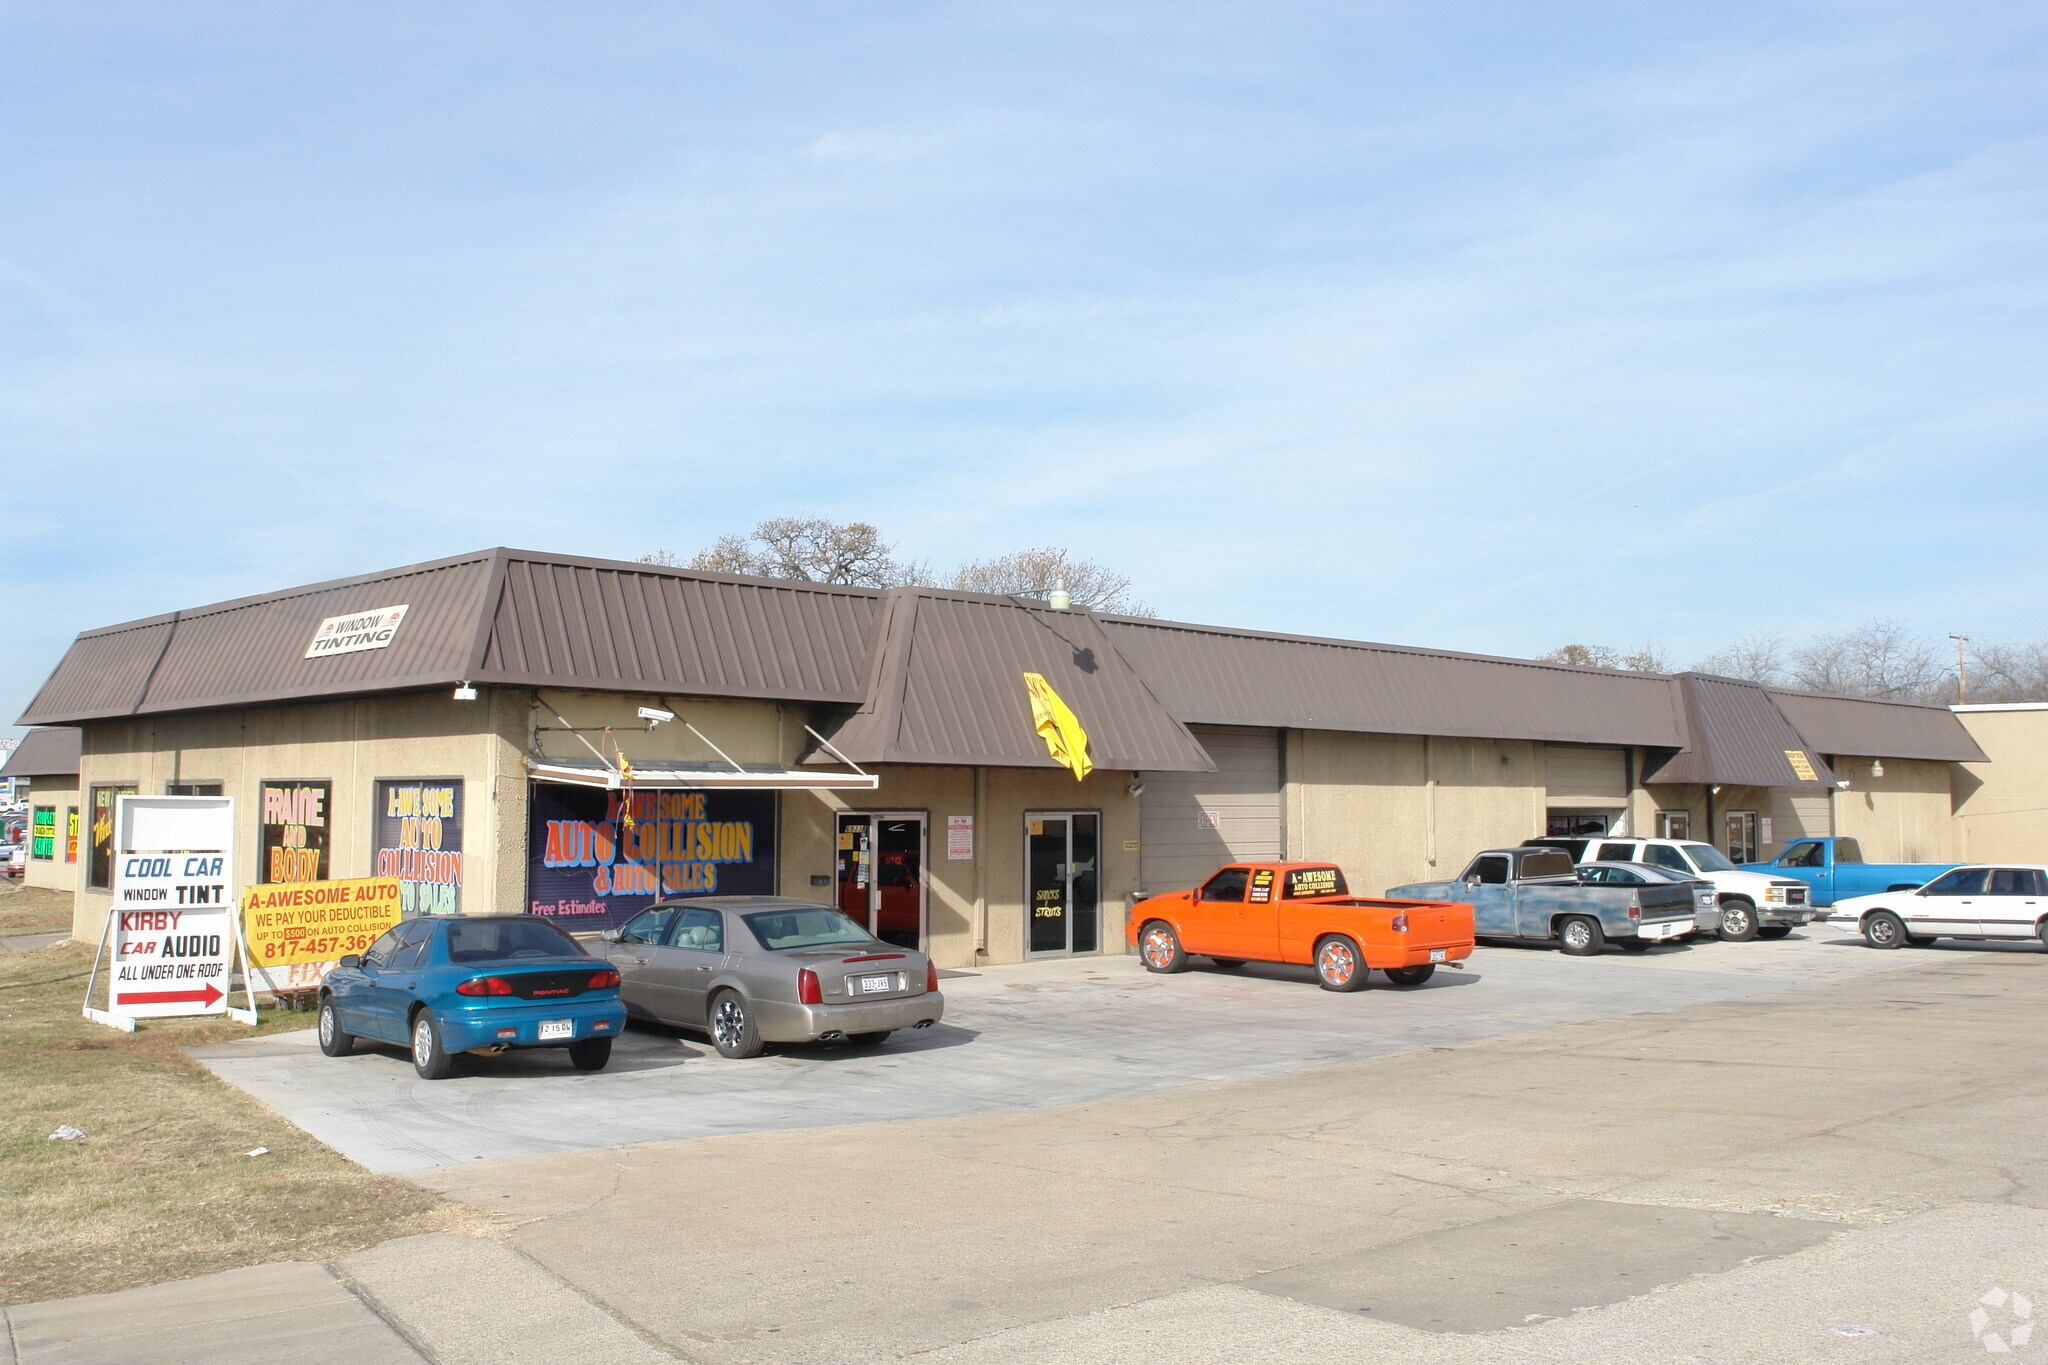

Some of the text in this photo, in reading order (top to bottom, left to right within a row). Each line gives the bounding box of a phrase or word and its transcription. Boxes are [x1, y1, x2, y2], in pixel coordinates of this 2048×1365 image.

[336, 614, 383, 634] WINDOW
[314, 630, 392, 651] TINTING
[264, 787, 325, 827] FRAME
[283, 825, 306, 848] AND
[399, 816, 443, 850] AUTO
[544, 820, 753, 867] AUTO COLLISION
[125, 857, 224, 878] COOL CAR
[271, 847, 320, 883] BODY
[377, 848, 463, 886] COLLISION
[593, 862, 718, 896] & AUTO SALES
[1309, 882, 1334, 890] COLLISION
[124, 885, 224, 904] WINDOW TINT
[248, 884, 398, 910] A-AWESOME AUTO
[419, 884, 456, 915] SALES
[255, 905, 391, 927] WE PAY YOUR DEDUCTIBLE
[532, 899, 606, 915] Free Estimates
[1035, 906, 1062, 917] STRUTS
[120, 911, 183, 932] KIRBY
[256, 932, 268, 941] UP
[271, 930, 283, 940] TO
[307, 927, 319, 937] ON
[321, 925, 344, 935] AUTO
[347, 922, 392, 932] COLLISION
[120, 935, 220, 957] CAR AUDIO
[265, 934, 376, 958] 817-457-361
[118, 963, 223, 981] ALL UNDER ONE ROOF
[533, 988, 570, 996] PONTIAC
